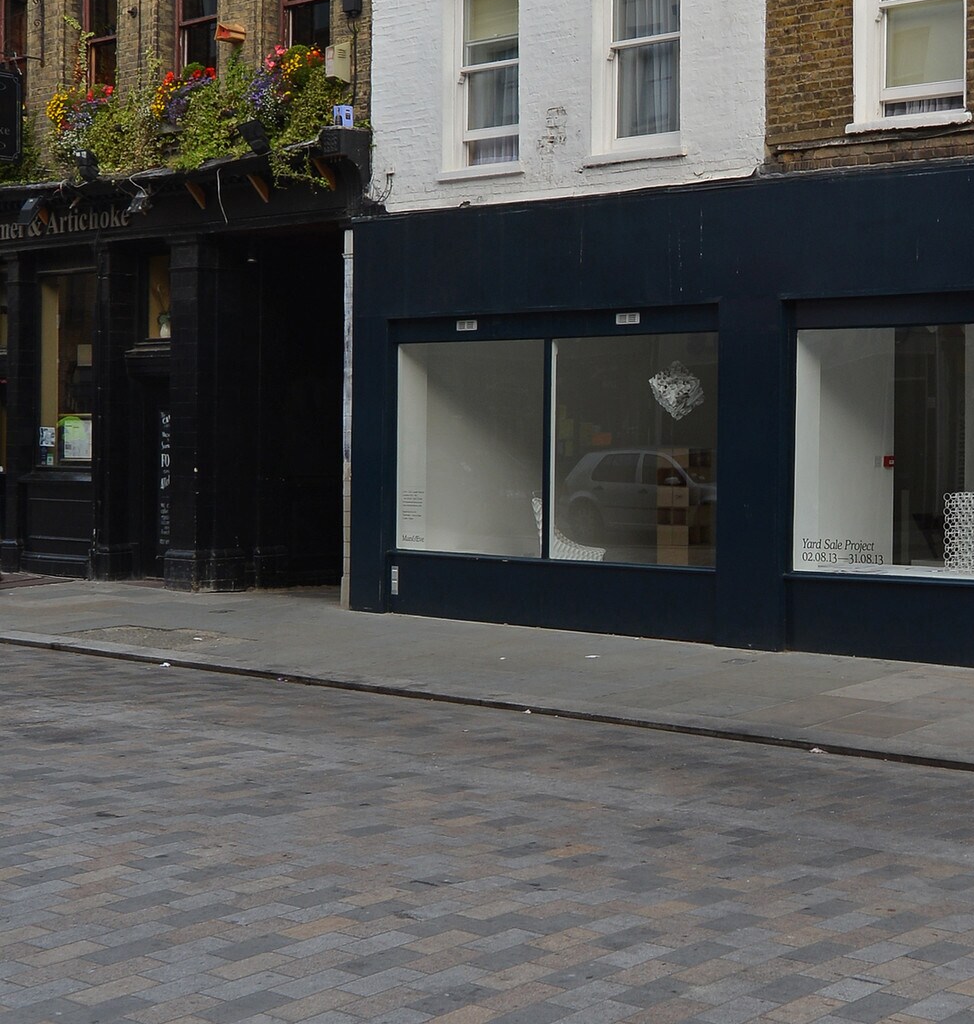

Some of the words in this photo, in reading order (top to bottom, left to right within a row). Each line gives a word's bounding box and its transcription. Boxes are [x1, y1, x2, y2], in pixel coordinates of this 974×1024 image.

[46, 204, 130, 235] Artichoke
[802, 538, 822, 549] Yard
[824, 538, 843, 550] Sale
[844, 539, 875, 553] Project
